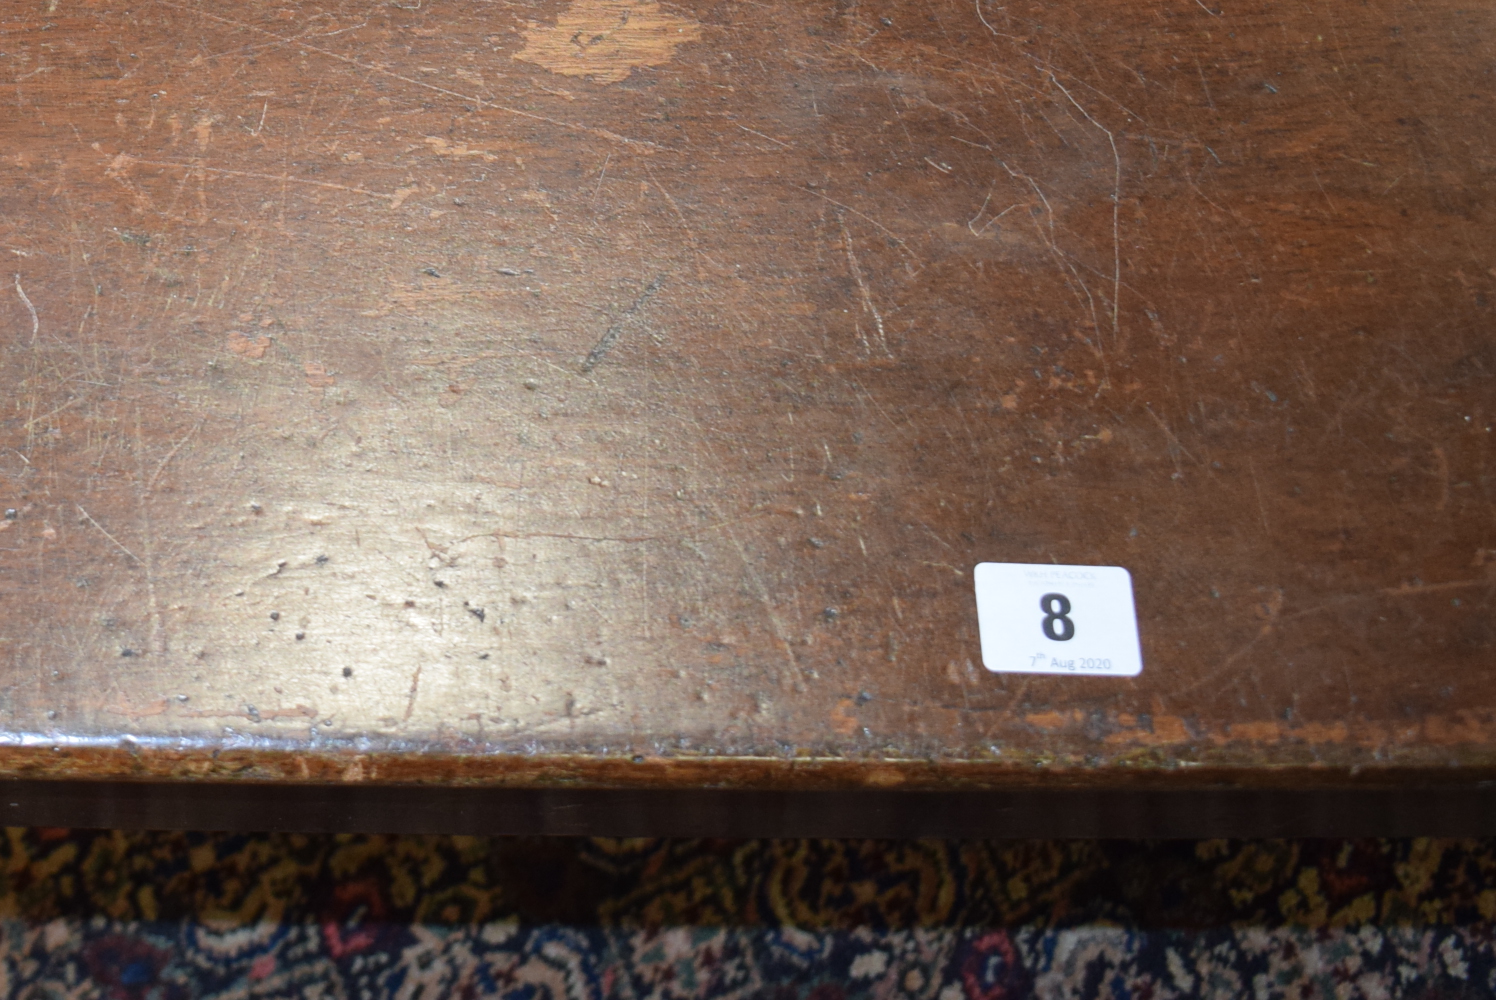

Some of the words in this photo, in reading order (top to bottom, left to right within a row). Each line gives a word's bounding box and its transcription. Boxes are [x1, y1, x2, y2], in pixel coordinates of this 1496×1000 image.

[1039, 592, 1075, 642] 8
[1028, 652, 1046, 667] 7th
[1050, 657, 1076, 671] Aug
[1078, 657, 1111, 670] 2020
